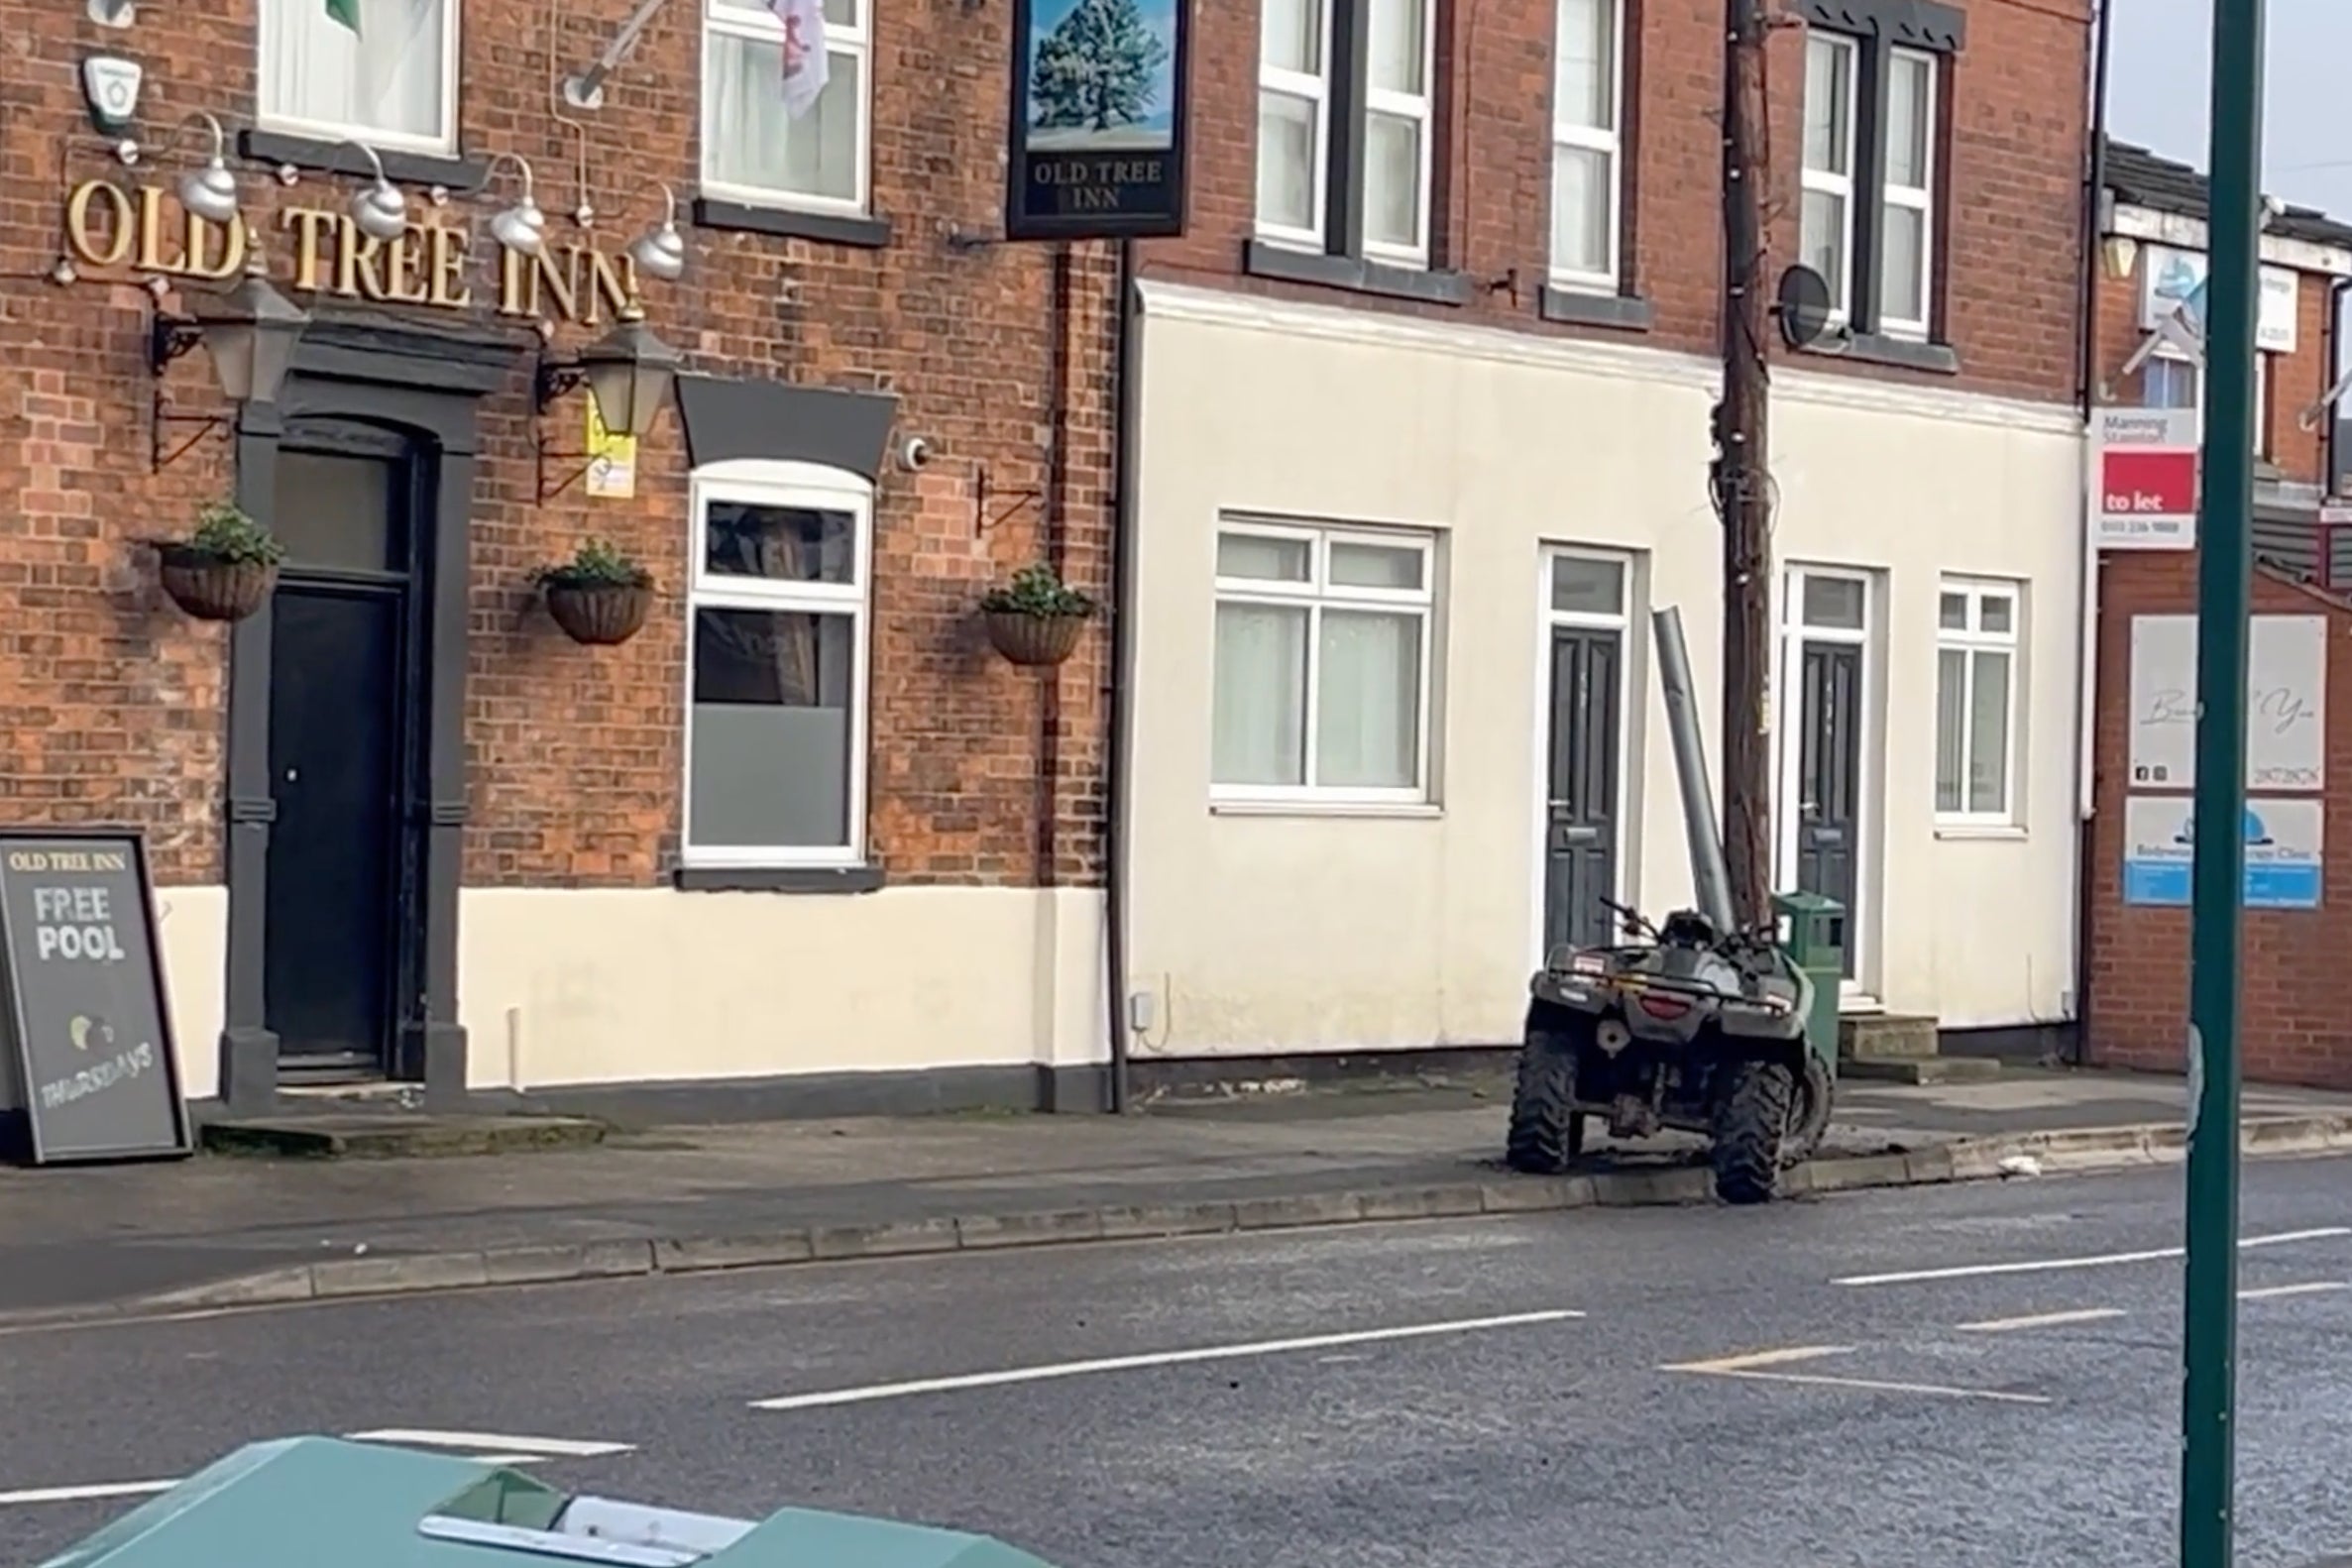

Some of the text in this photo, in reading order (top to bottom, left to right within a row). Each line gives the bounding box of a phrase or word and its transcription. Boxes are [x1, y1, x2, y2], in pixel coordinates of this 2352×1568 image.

[1034, 161, 1163, 184] OLD TREE
[1073, 186, 1120, 208] INN
[69, 178, 639, 324] OLD TREE INN
[2106, 490, 2164, 510] to let
[9, 851, 126, 871] OLD TREE INN
[34, 887, 111, 922] FREE
[37, 925, 125, 960] POOL
